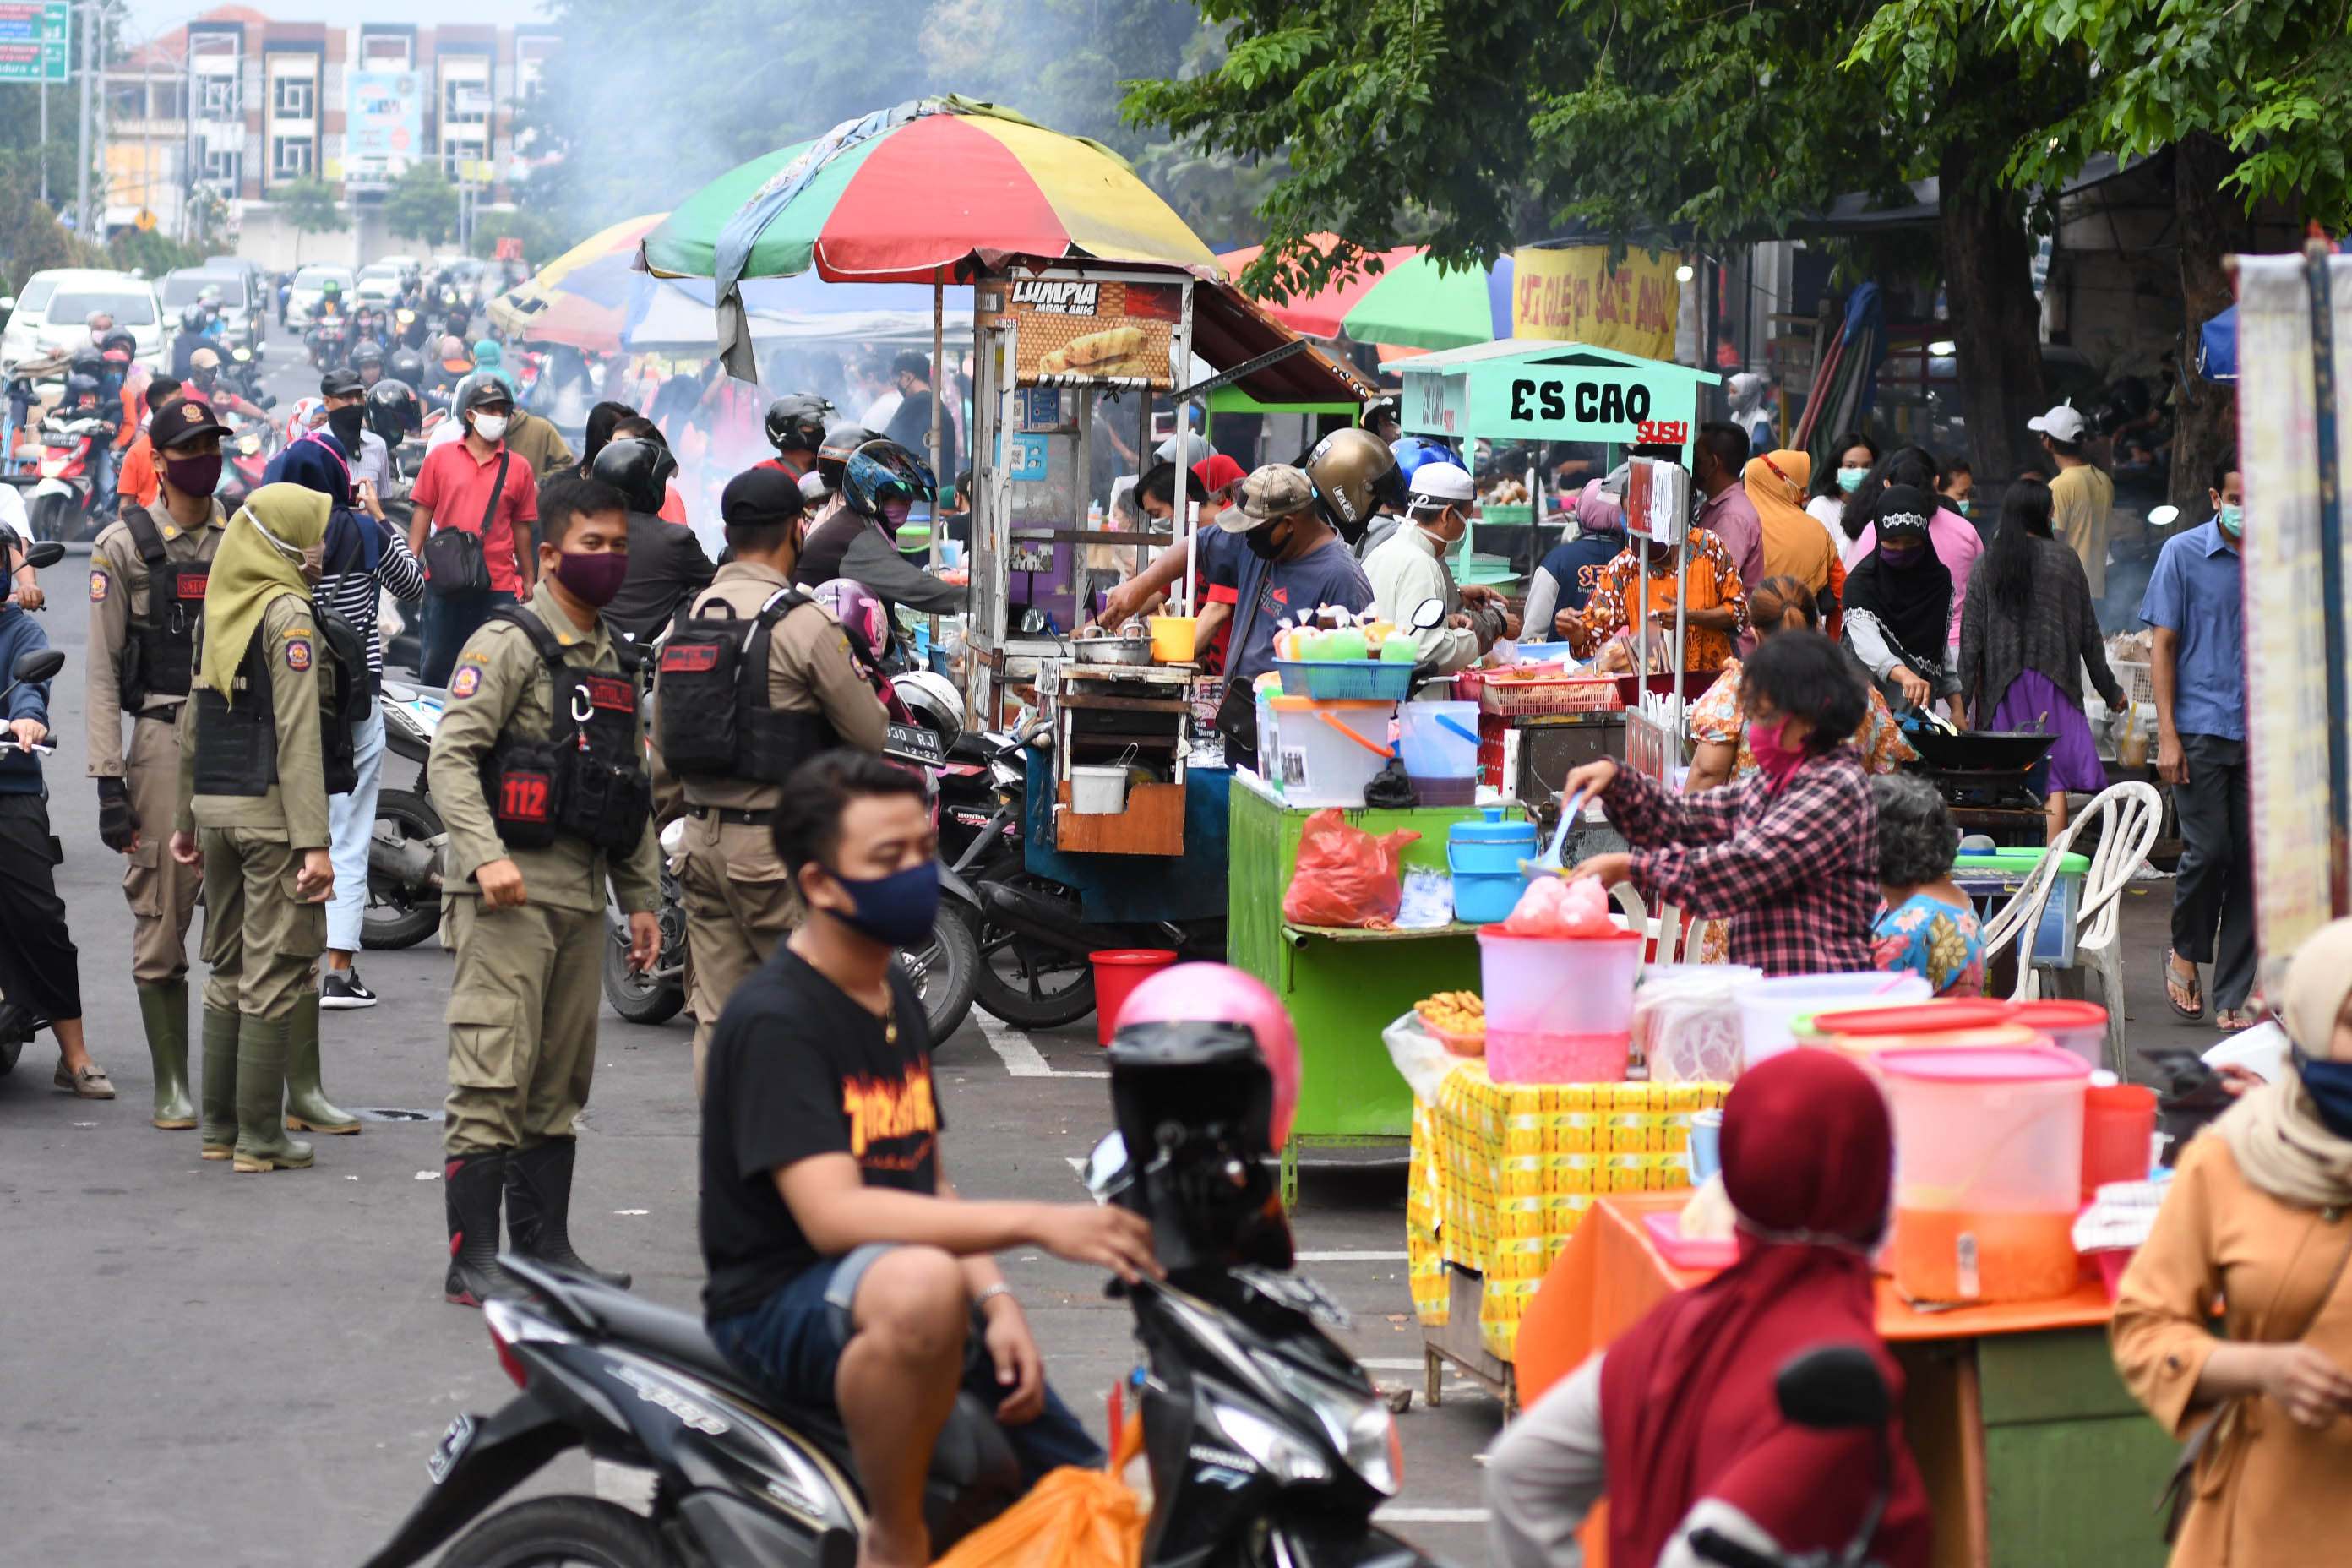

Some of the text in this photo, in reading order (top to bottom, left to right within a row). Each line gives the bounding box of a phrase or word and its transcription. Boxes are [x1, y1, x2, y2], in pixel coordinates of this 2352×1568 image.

[1012, 281, 1097, 304] LUMPIA
[1069, 304, 1095, 315] ANIS
[1511, 379, 1650, 424] ES CAO
[1636, 420, 1688, 445] SUSU
[917, 732, 934, 748] RJ
[504, 779, 547, 817] 112
[957, 812, 987, 820] HONDA
